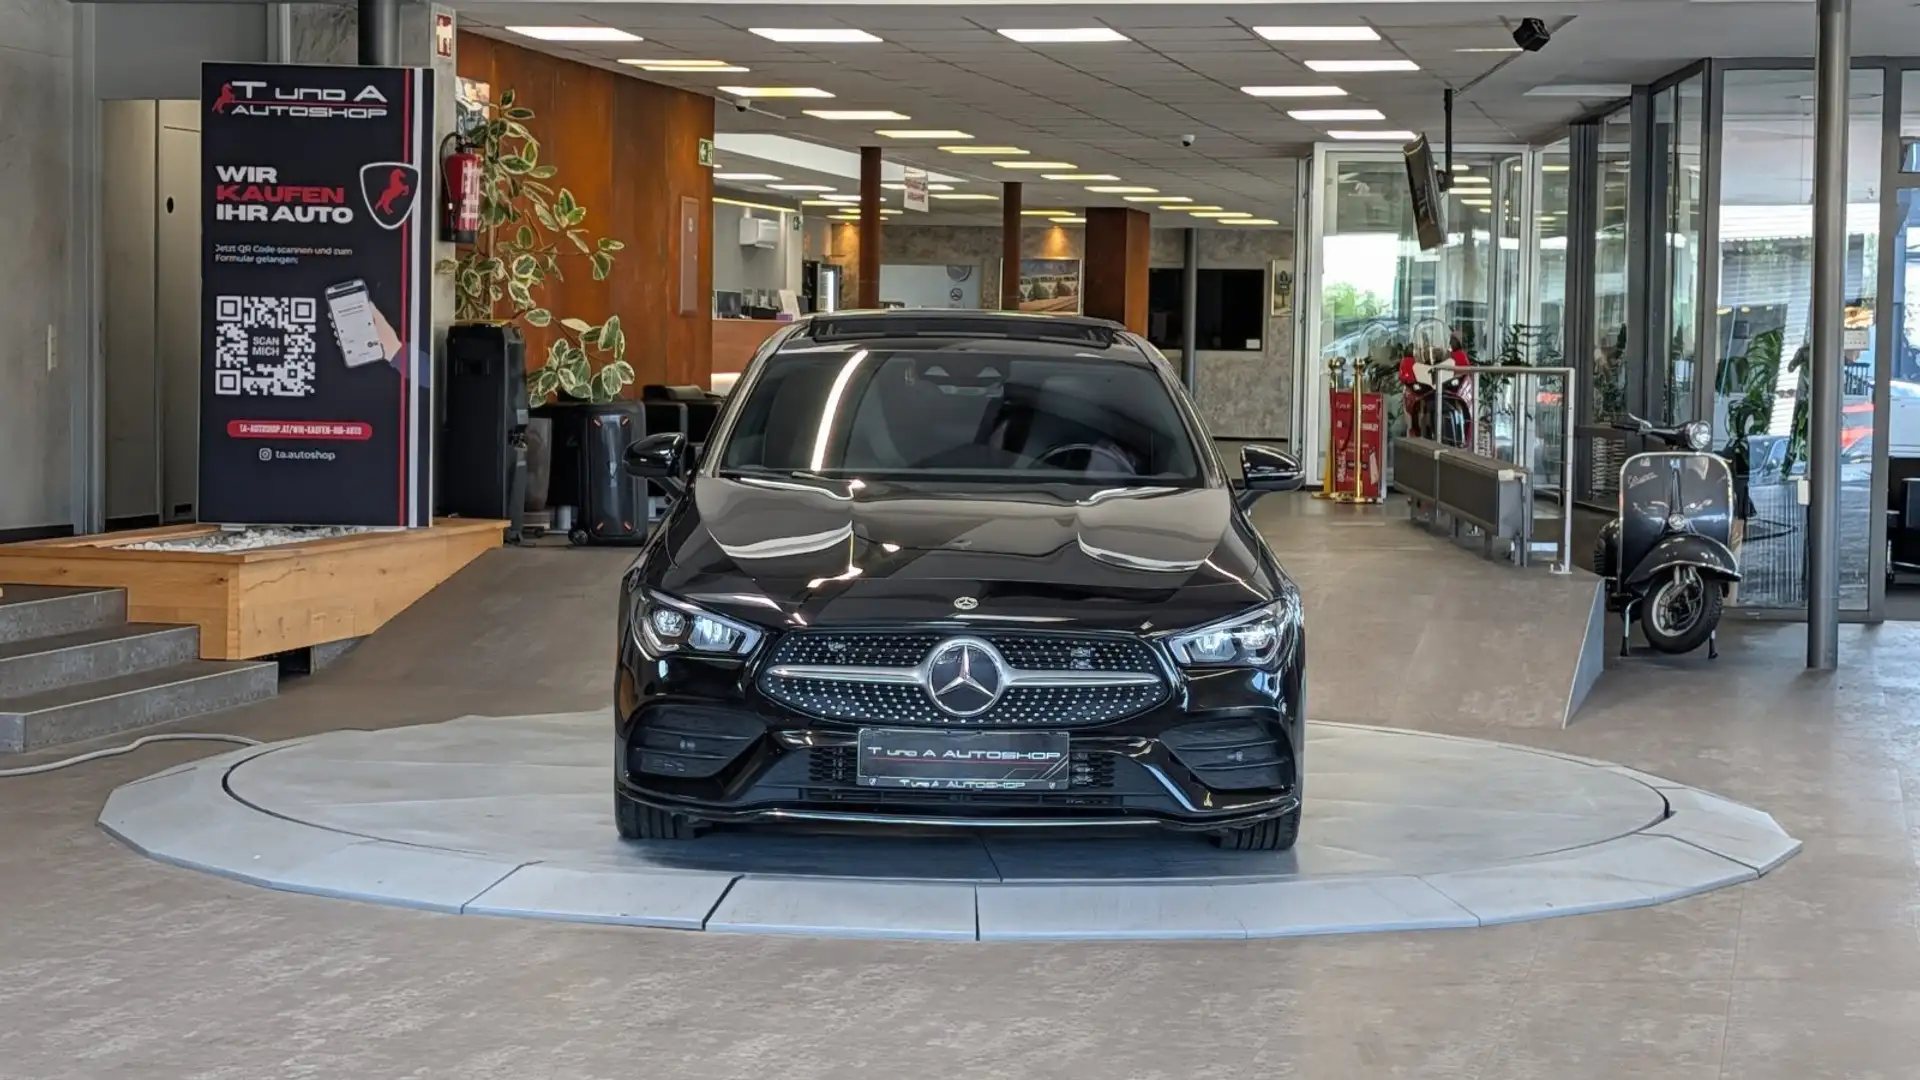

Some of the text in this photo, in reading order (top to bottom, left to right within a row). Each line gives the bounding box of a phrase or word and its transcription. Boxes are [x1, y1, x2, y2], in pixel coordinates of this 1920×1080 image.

[231, 81, 268, 99] T
[353, 85, 388, 103] A
[231, 105, 388, 119] AUTOSHOP
[215, 165, 278, 184] WIR
[216, 184, 345, 204] KAUFEN
[216, 203, 354, 224] IHR AUTO
[215, 243, 353, 256] Jetzt QR Code scannen und zum
[215, 253, 255, 263] Formular
[252, 336, 280, 346] SCAN
[252, 346, 280, 356] MICH
[275, 450, 336, 461] ta.autoshop
[867, 746, 882, 755] T
[922, 749, 937, 758] A
[942, 749, 1061, 760] AUTOSHOP
[946, 780, 1026, 789] AUTOSHOP
